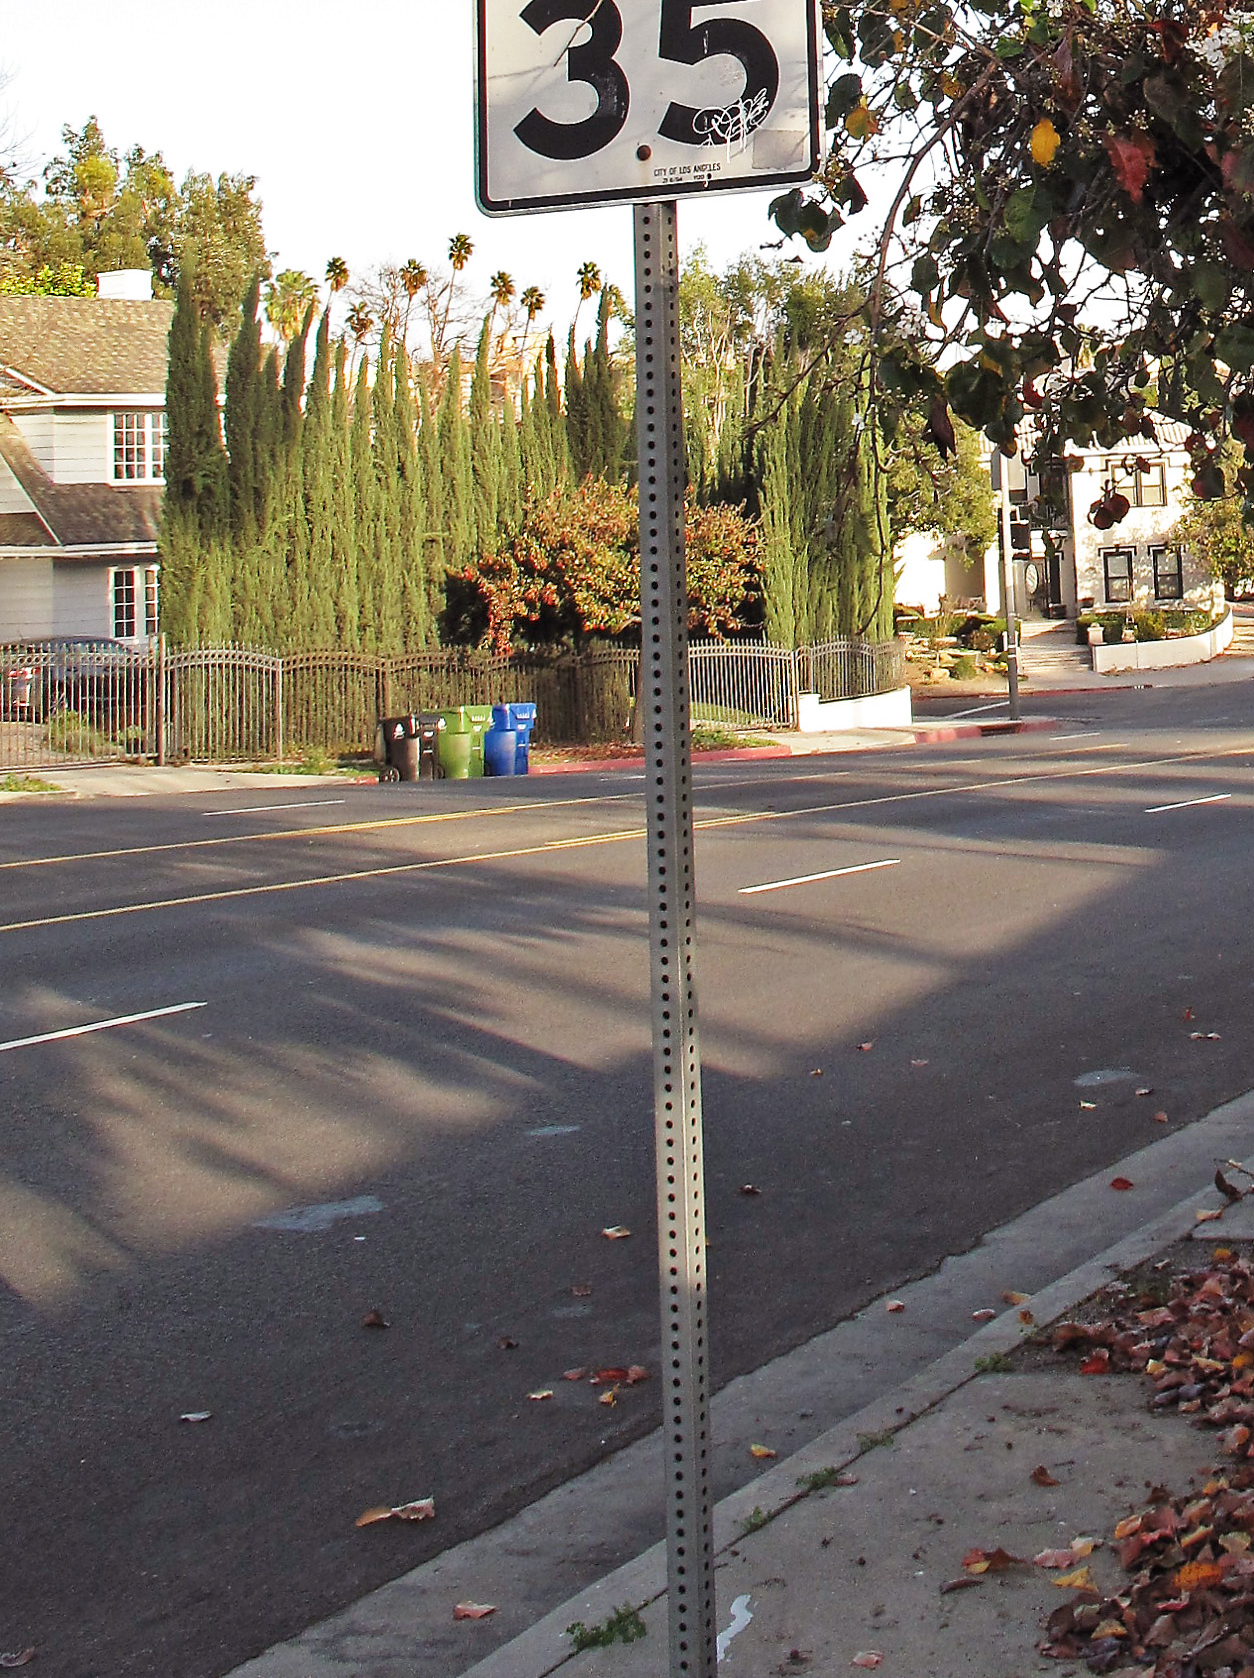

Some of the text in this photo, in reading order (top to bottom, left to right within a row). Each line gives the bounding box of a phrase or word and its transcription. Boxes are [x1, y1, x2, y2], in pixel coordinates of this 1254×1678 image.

[653, 162, 721, 177] CITY OF LOS ANGELES
